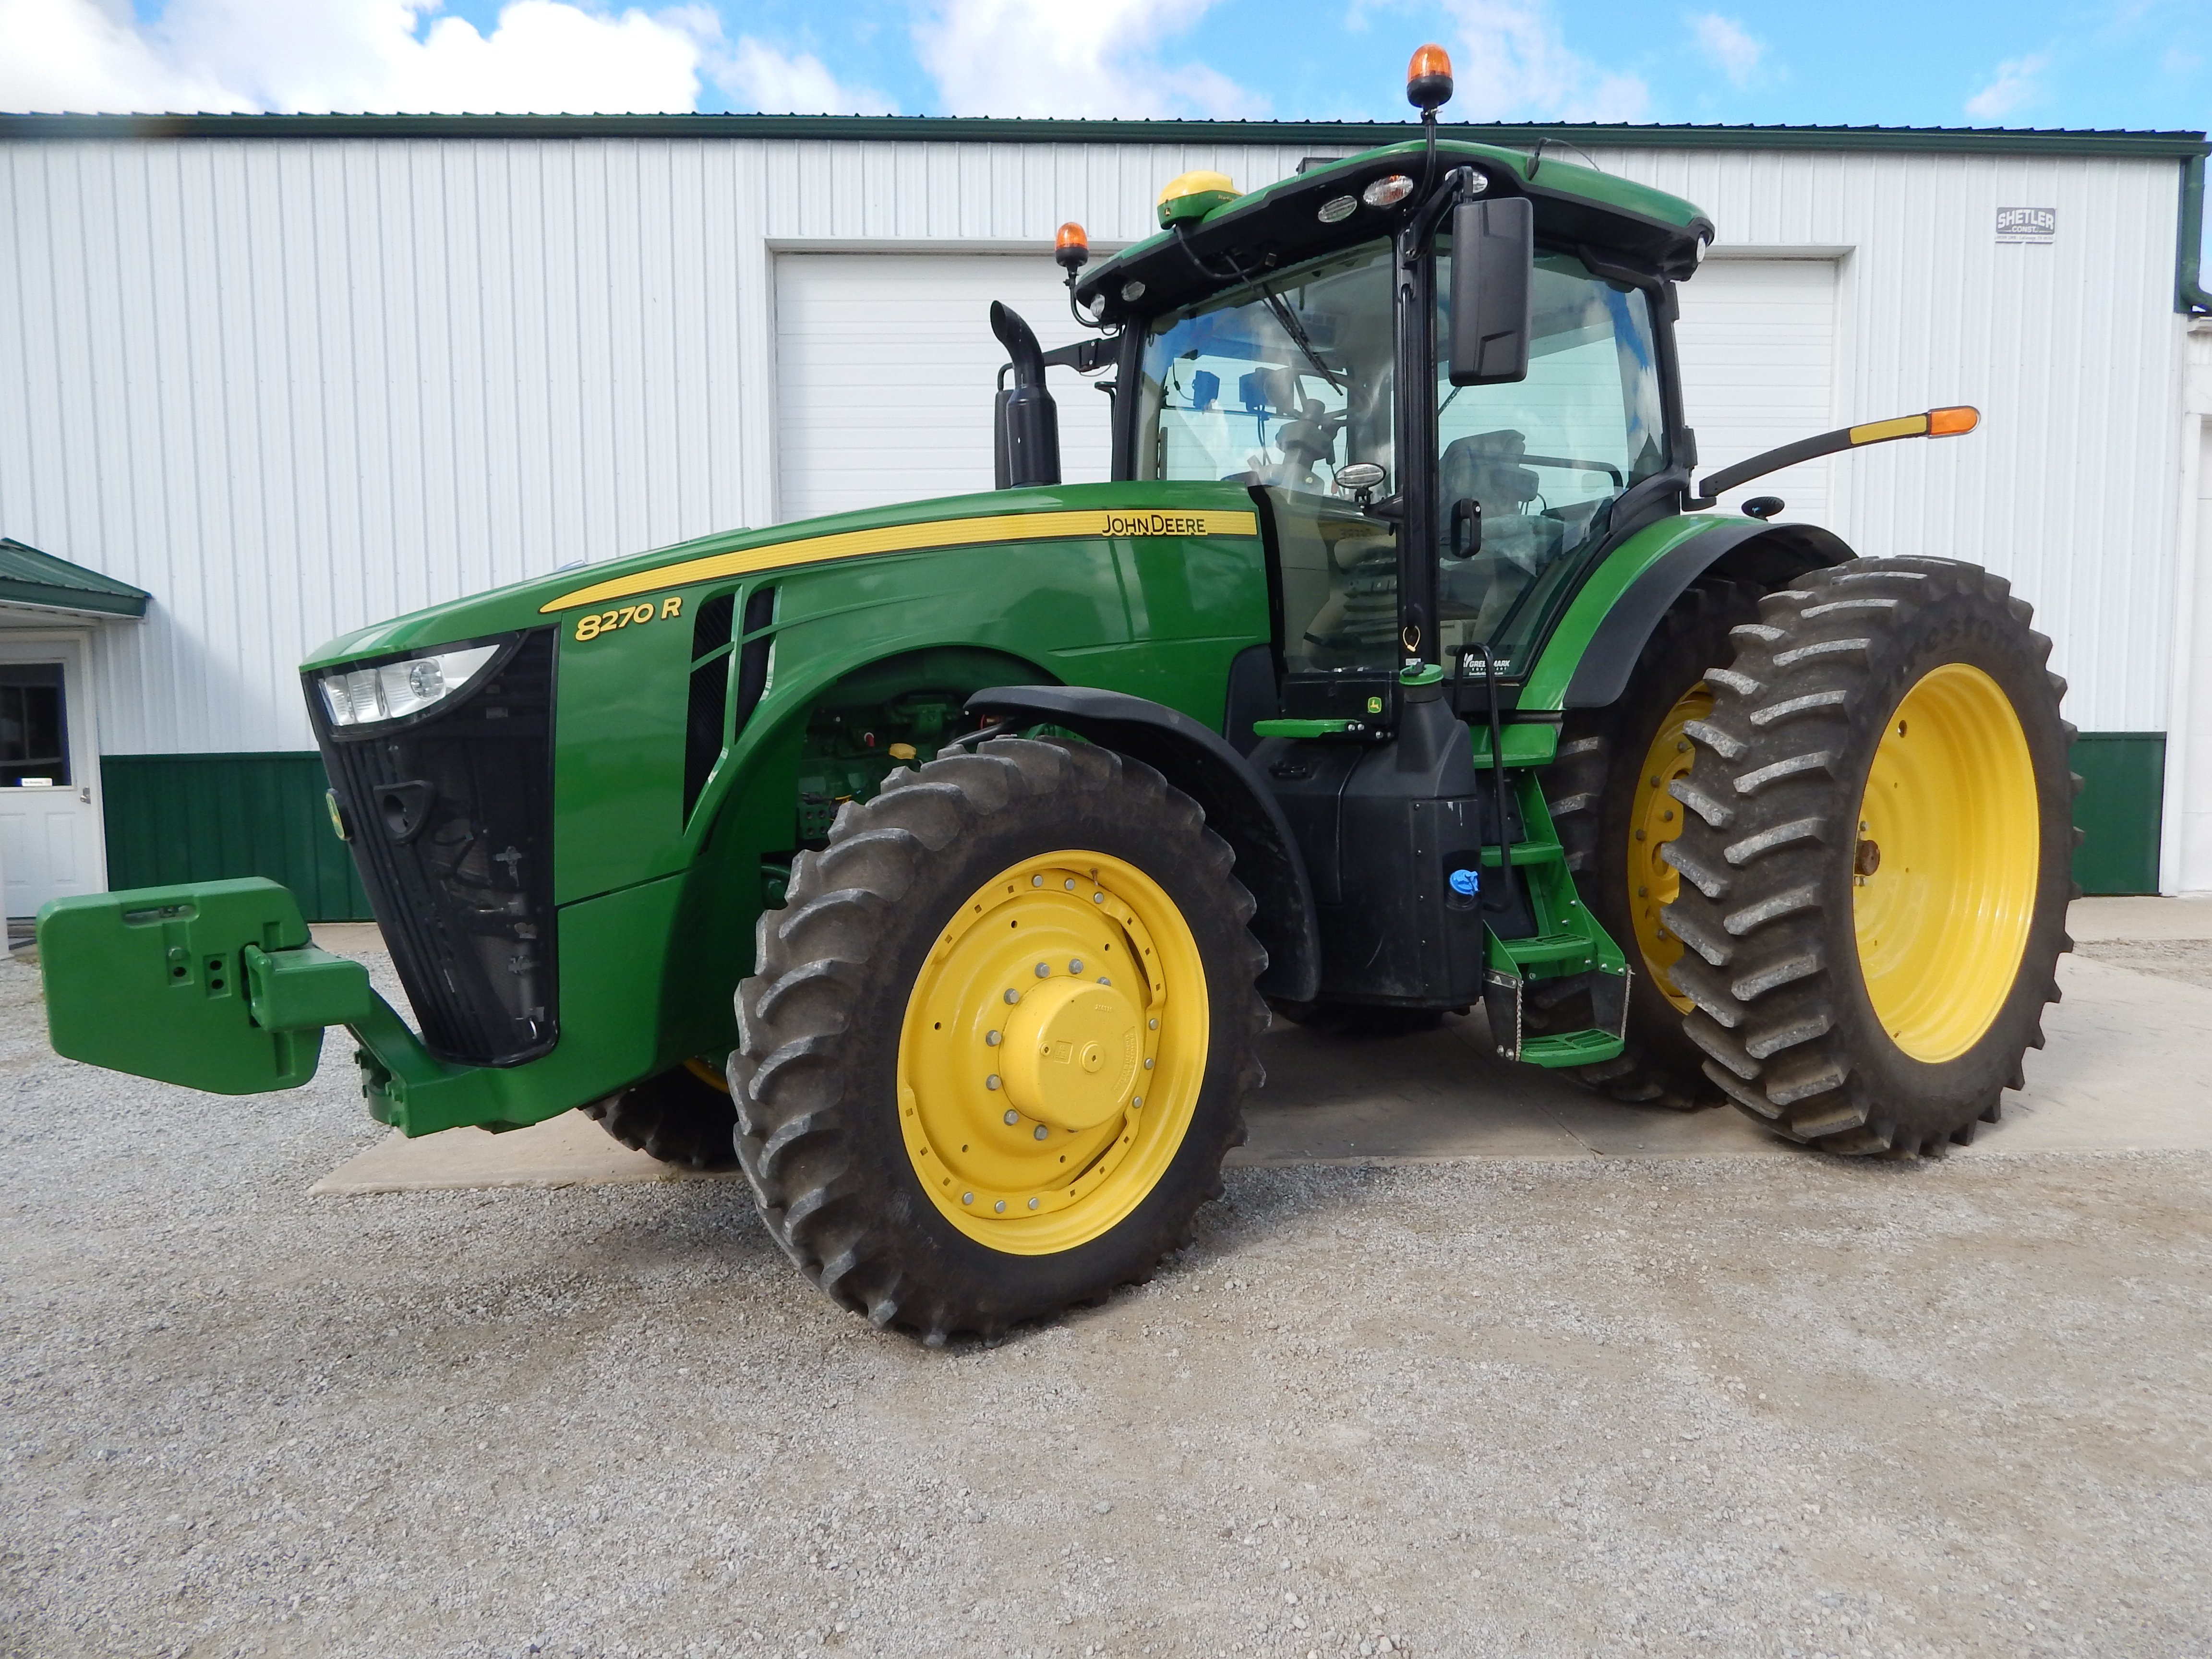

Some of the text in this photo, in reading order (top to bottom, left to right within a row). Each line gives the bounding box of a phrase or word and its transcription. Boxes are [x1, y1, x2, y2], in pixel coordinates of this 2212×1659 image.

[1997, 209, 2054, 229] SHETLER
[575, 597, 682, 641] 8270 R
